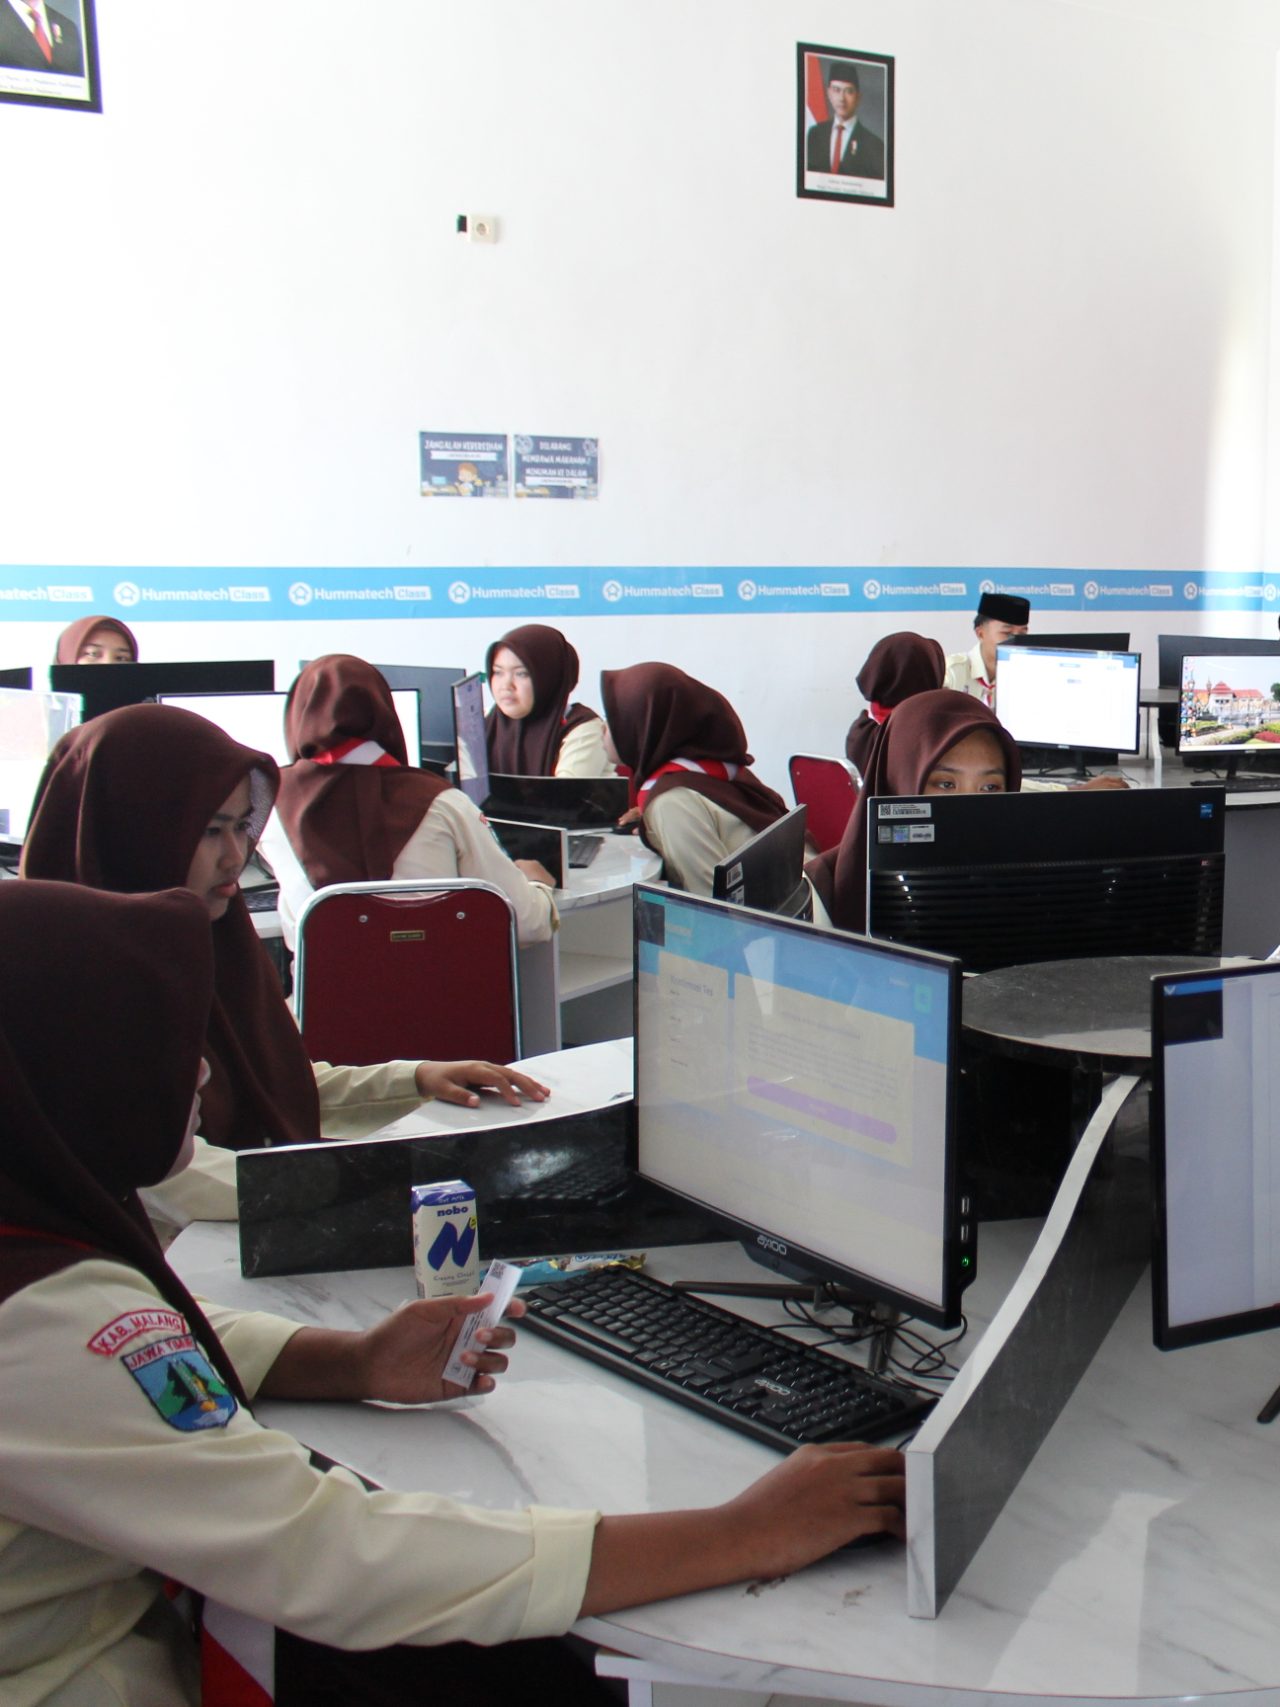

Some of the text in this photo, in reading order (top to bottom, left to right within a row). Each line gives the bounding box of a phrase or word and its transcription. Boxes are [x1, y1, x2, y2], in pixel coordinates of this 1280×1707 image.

[0, 586, 47, 601] atech
[142, 587, 228, 601] Hummatech
[314, 587, 394, 600] Hummatech
[472, 586, 545, 598] Hummatech
[624, 585, 692, 598] Hummatech
[758, 584, 820, 596] Hummatech
[882, 584, 940, 595] Hummatech
[996, 584, 1050, 595] Hummatech
[437, 1206, 469, 1217] nobo
[98, 1314, 181, 1351] KAB. MALANG
[130, 1343, 165, 1369] JAWA
